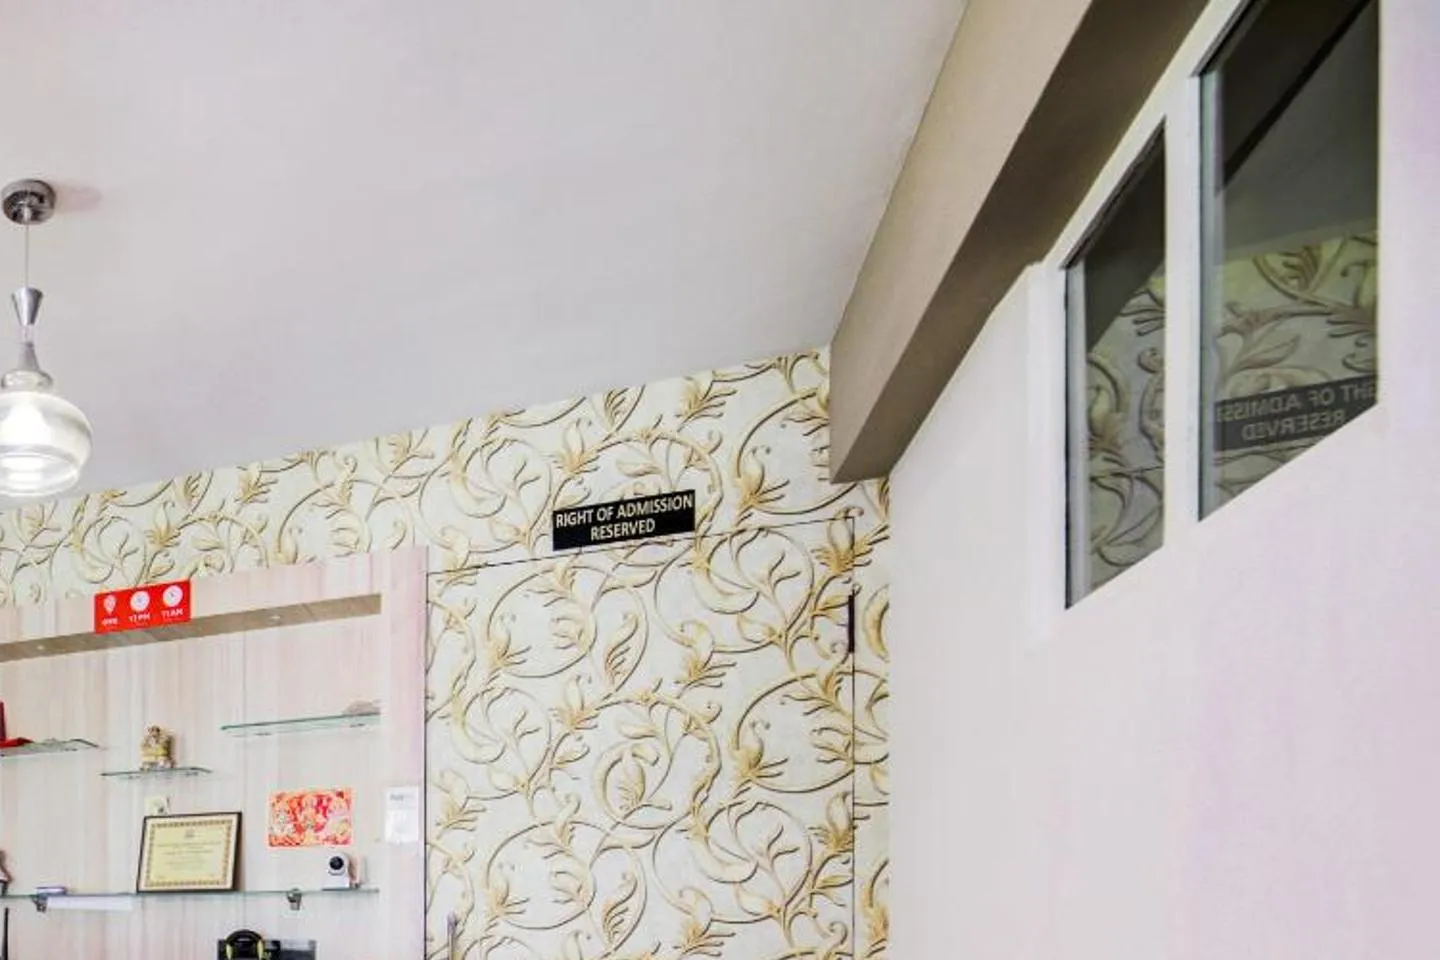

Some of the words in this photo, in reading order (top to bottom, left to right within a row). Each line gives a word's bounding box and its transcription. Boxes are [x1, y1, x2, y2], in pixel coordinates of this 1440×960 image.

[555, 508, 595, 529] RIGHT
[596, 505, 615, 522] OF
[616, 493, 693, 519] ADMISSION
[590, 518, 656, 541] RESERVED
